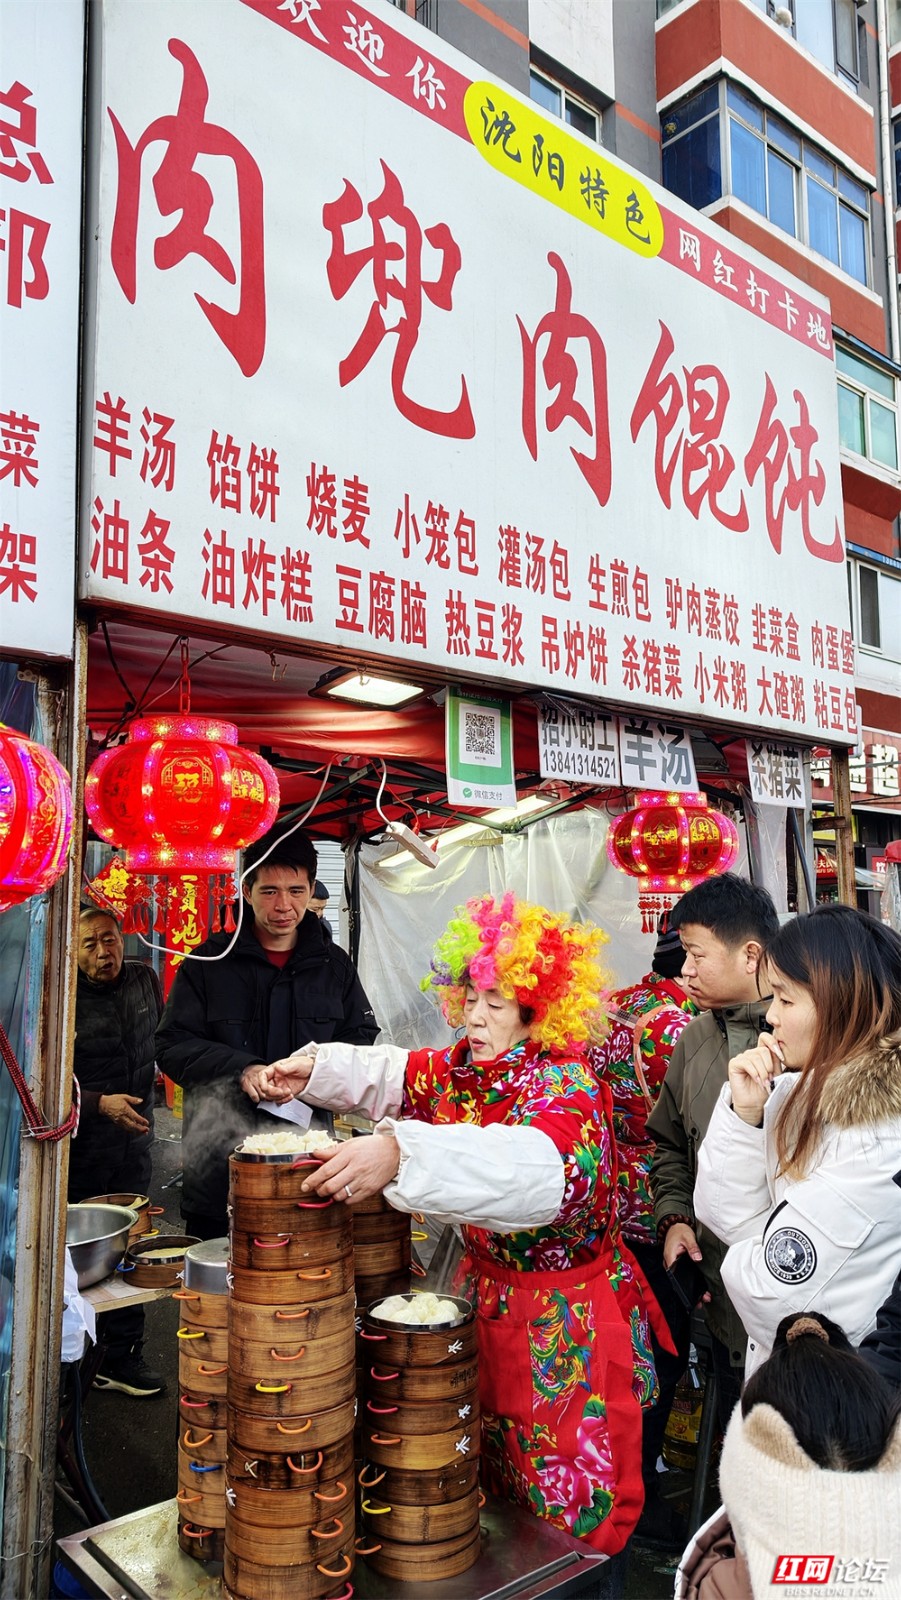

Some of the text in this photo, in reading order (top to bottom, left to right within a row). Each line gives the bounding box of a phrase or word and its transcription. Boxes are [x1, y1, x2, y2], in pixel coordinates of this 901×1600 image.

[481, 97, 651, 245] 沈阳特色
[107, 38, 845, 563] 肉兜肉馄饨
[679, 228, 831, 351] 网红打卡地
[94, 391, 854, 676] 羊汤 馅饼 烧麦 小笼包 灌汤包 生煎包 驴肉蒸饺 韭菜盒 肉蛋堡
[90, 496, 858, 735] 油条 油炸糕 豆腐脑 热豆浆 吊炉饼 杀猪菜 小米粥 大碴粥 粘豆包
[541, 704, 615, 751] 招小时工
[543, 749, 616, 779] 13841314521
[624, 717, 692, 785] 羊汤
[751, 742, 802, 800] 杀猪菜
[474, 789, 503, 801] 微信支付
